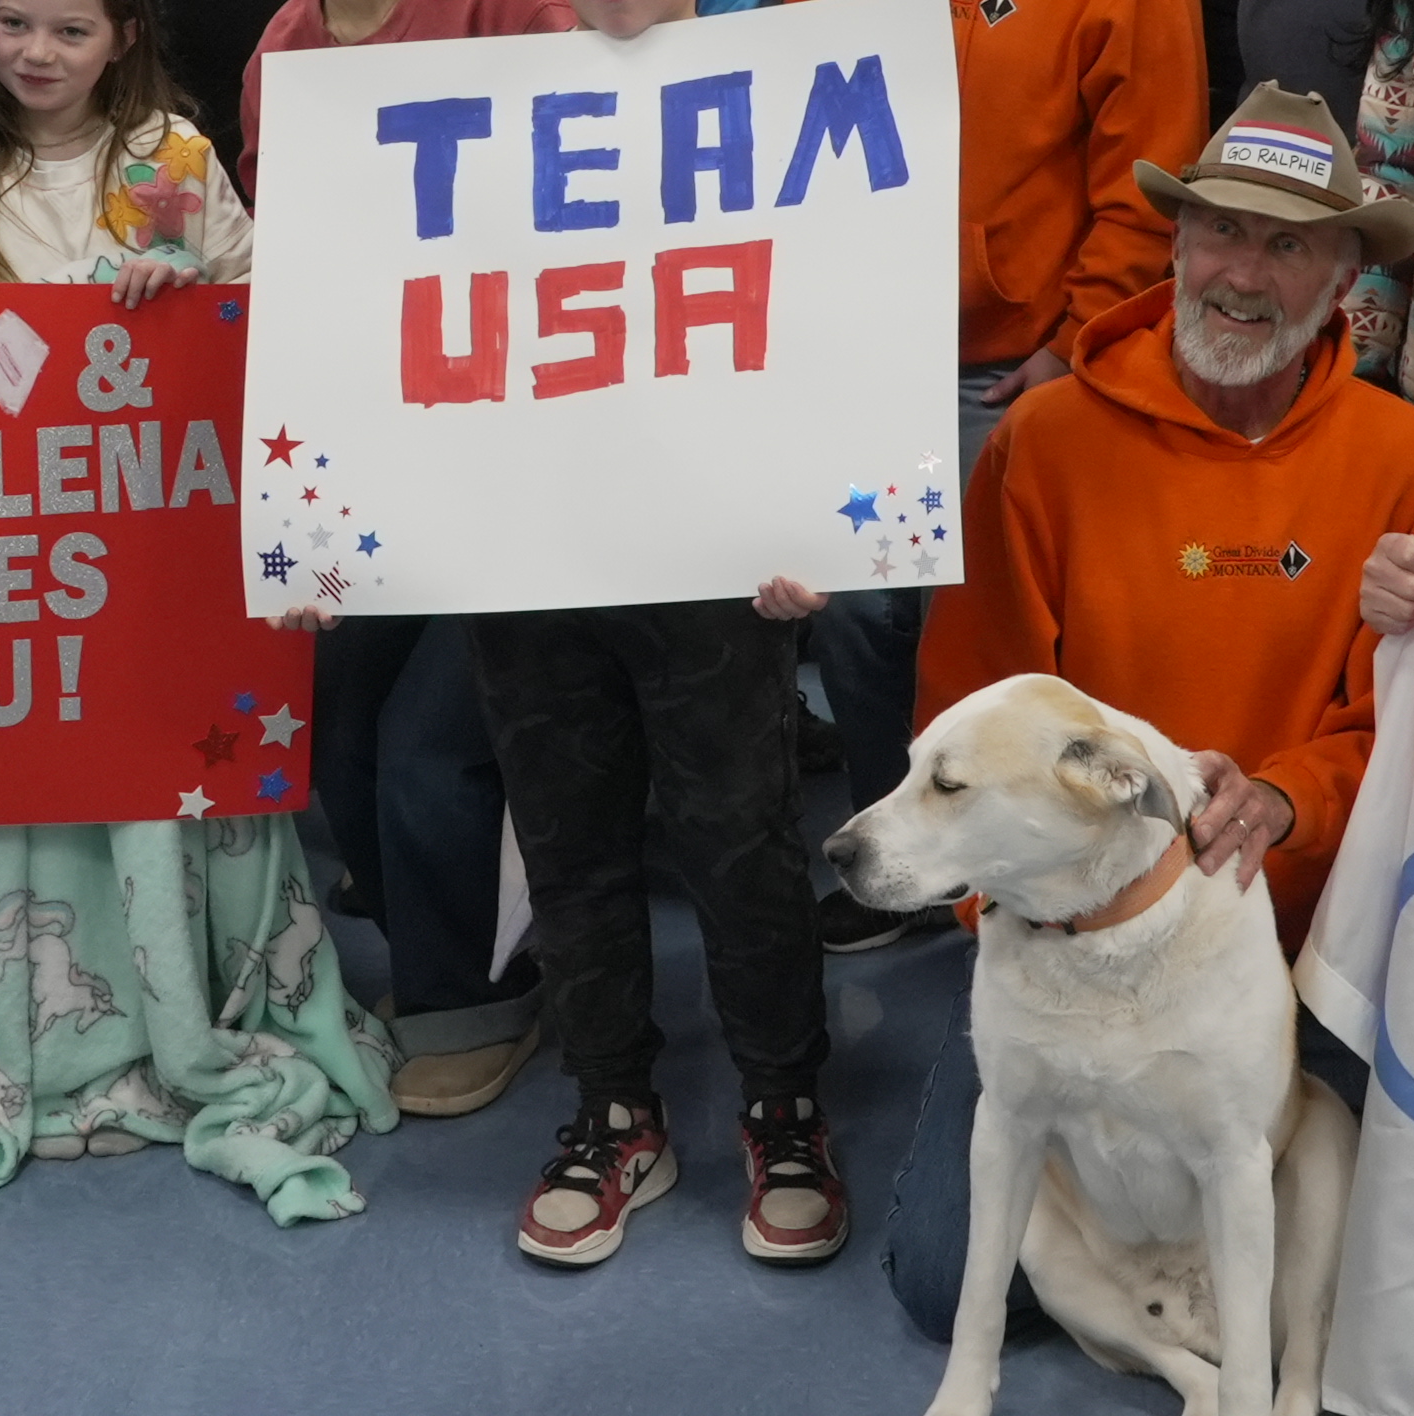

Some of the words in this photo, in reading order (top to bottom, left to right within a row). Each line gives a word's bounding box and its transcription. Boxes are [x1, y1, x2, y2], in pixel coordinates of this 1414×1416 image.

[375, 54, 909, 240] TEAM
[1227, 146, 1252, 162] GO
[1256, 148, 1327, 177] RALPHIE
[400, 239, 773, 408] USA
[77, 323, 153, 413] &
[1212, 563, 1281, 577] MONTANA
[1243, 545, 1281, 559] Divide
